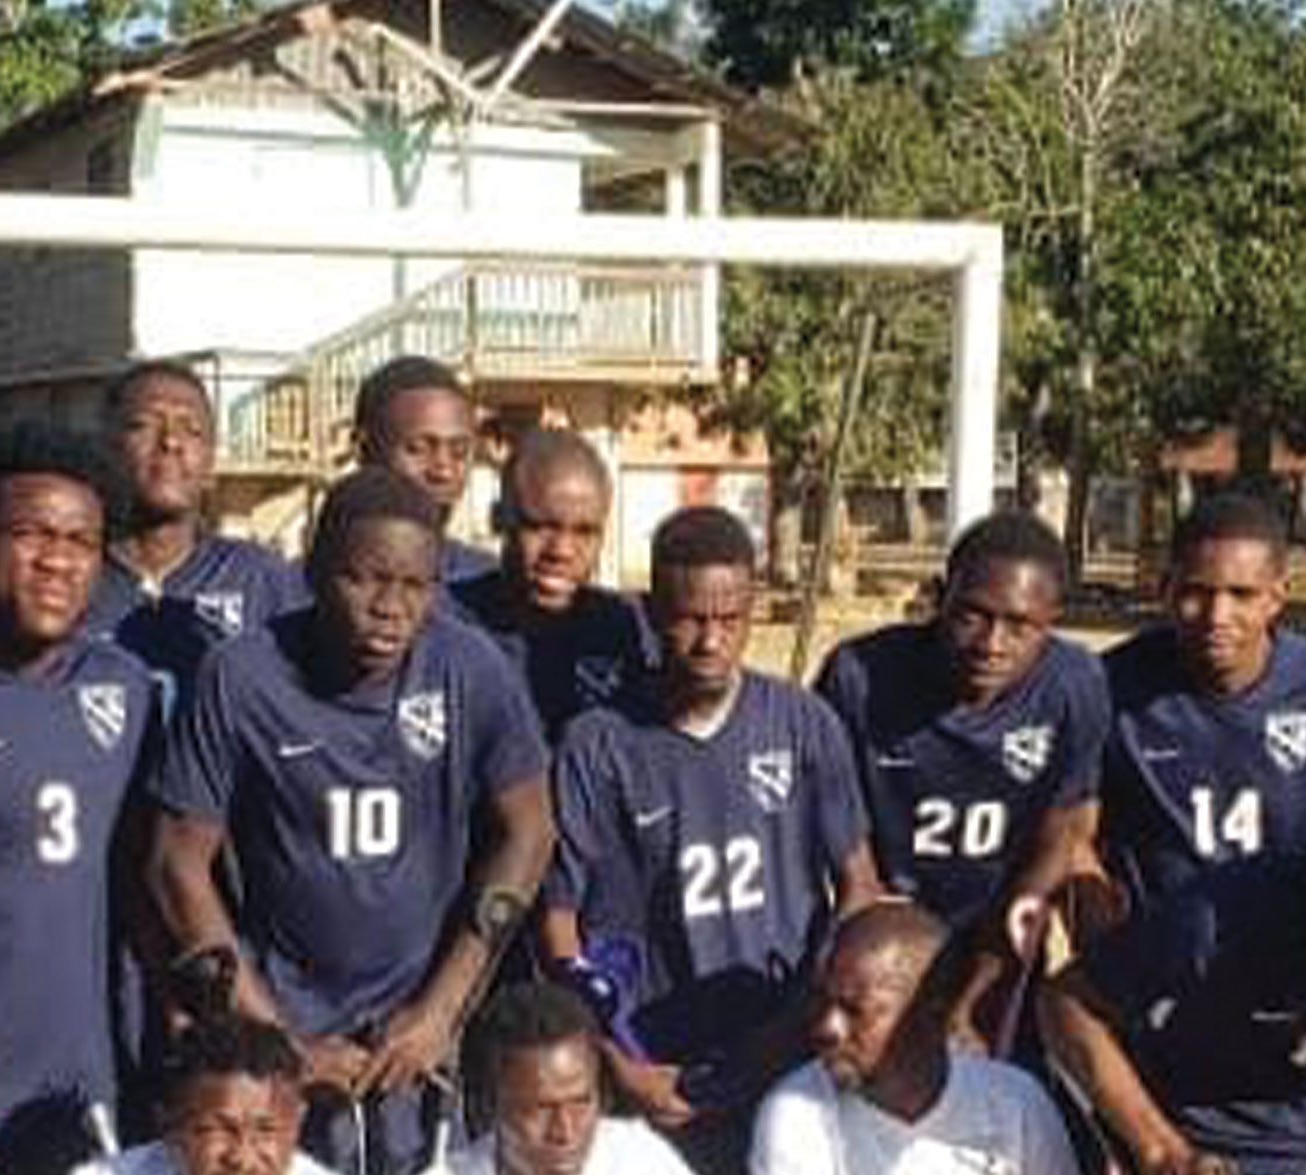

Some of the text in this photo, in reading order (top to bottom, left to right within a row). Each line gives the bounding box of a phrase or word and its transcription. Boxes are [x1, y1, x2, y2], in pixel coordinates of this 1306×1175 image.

[37, 780, 76, 862] 3
[328, 785, 401, 859] 10
[912, 797, 1006, 857] 20
[1191, 786, 1262, 857] 14
[679, 835, 765, 918] 22
